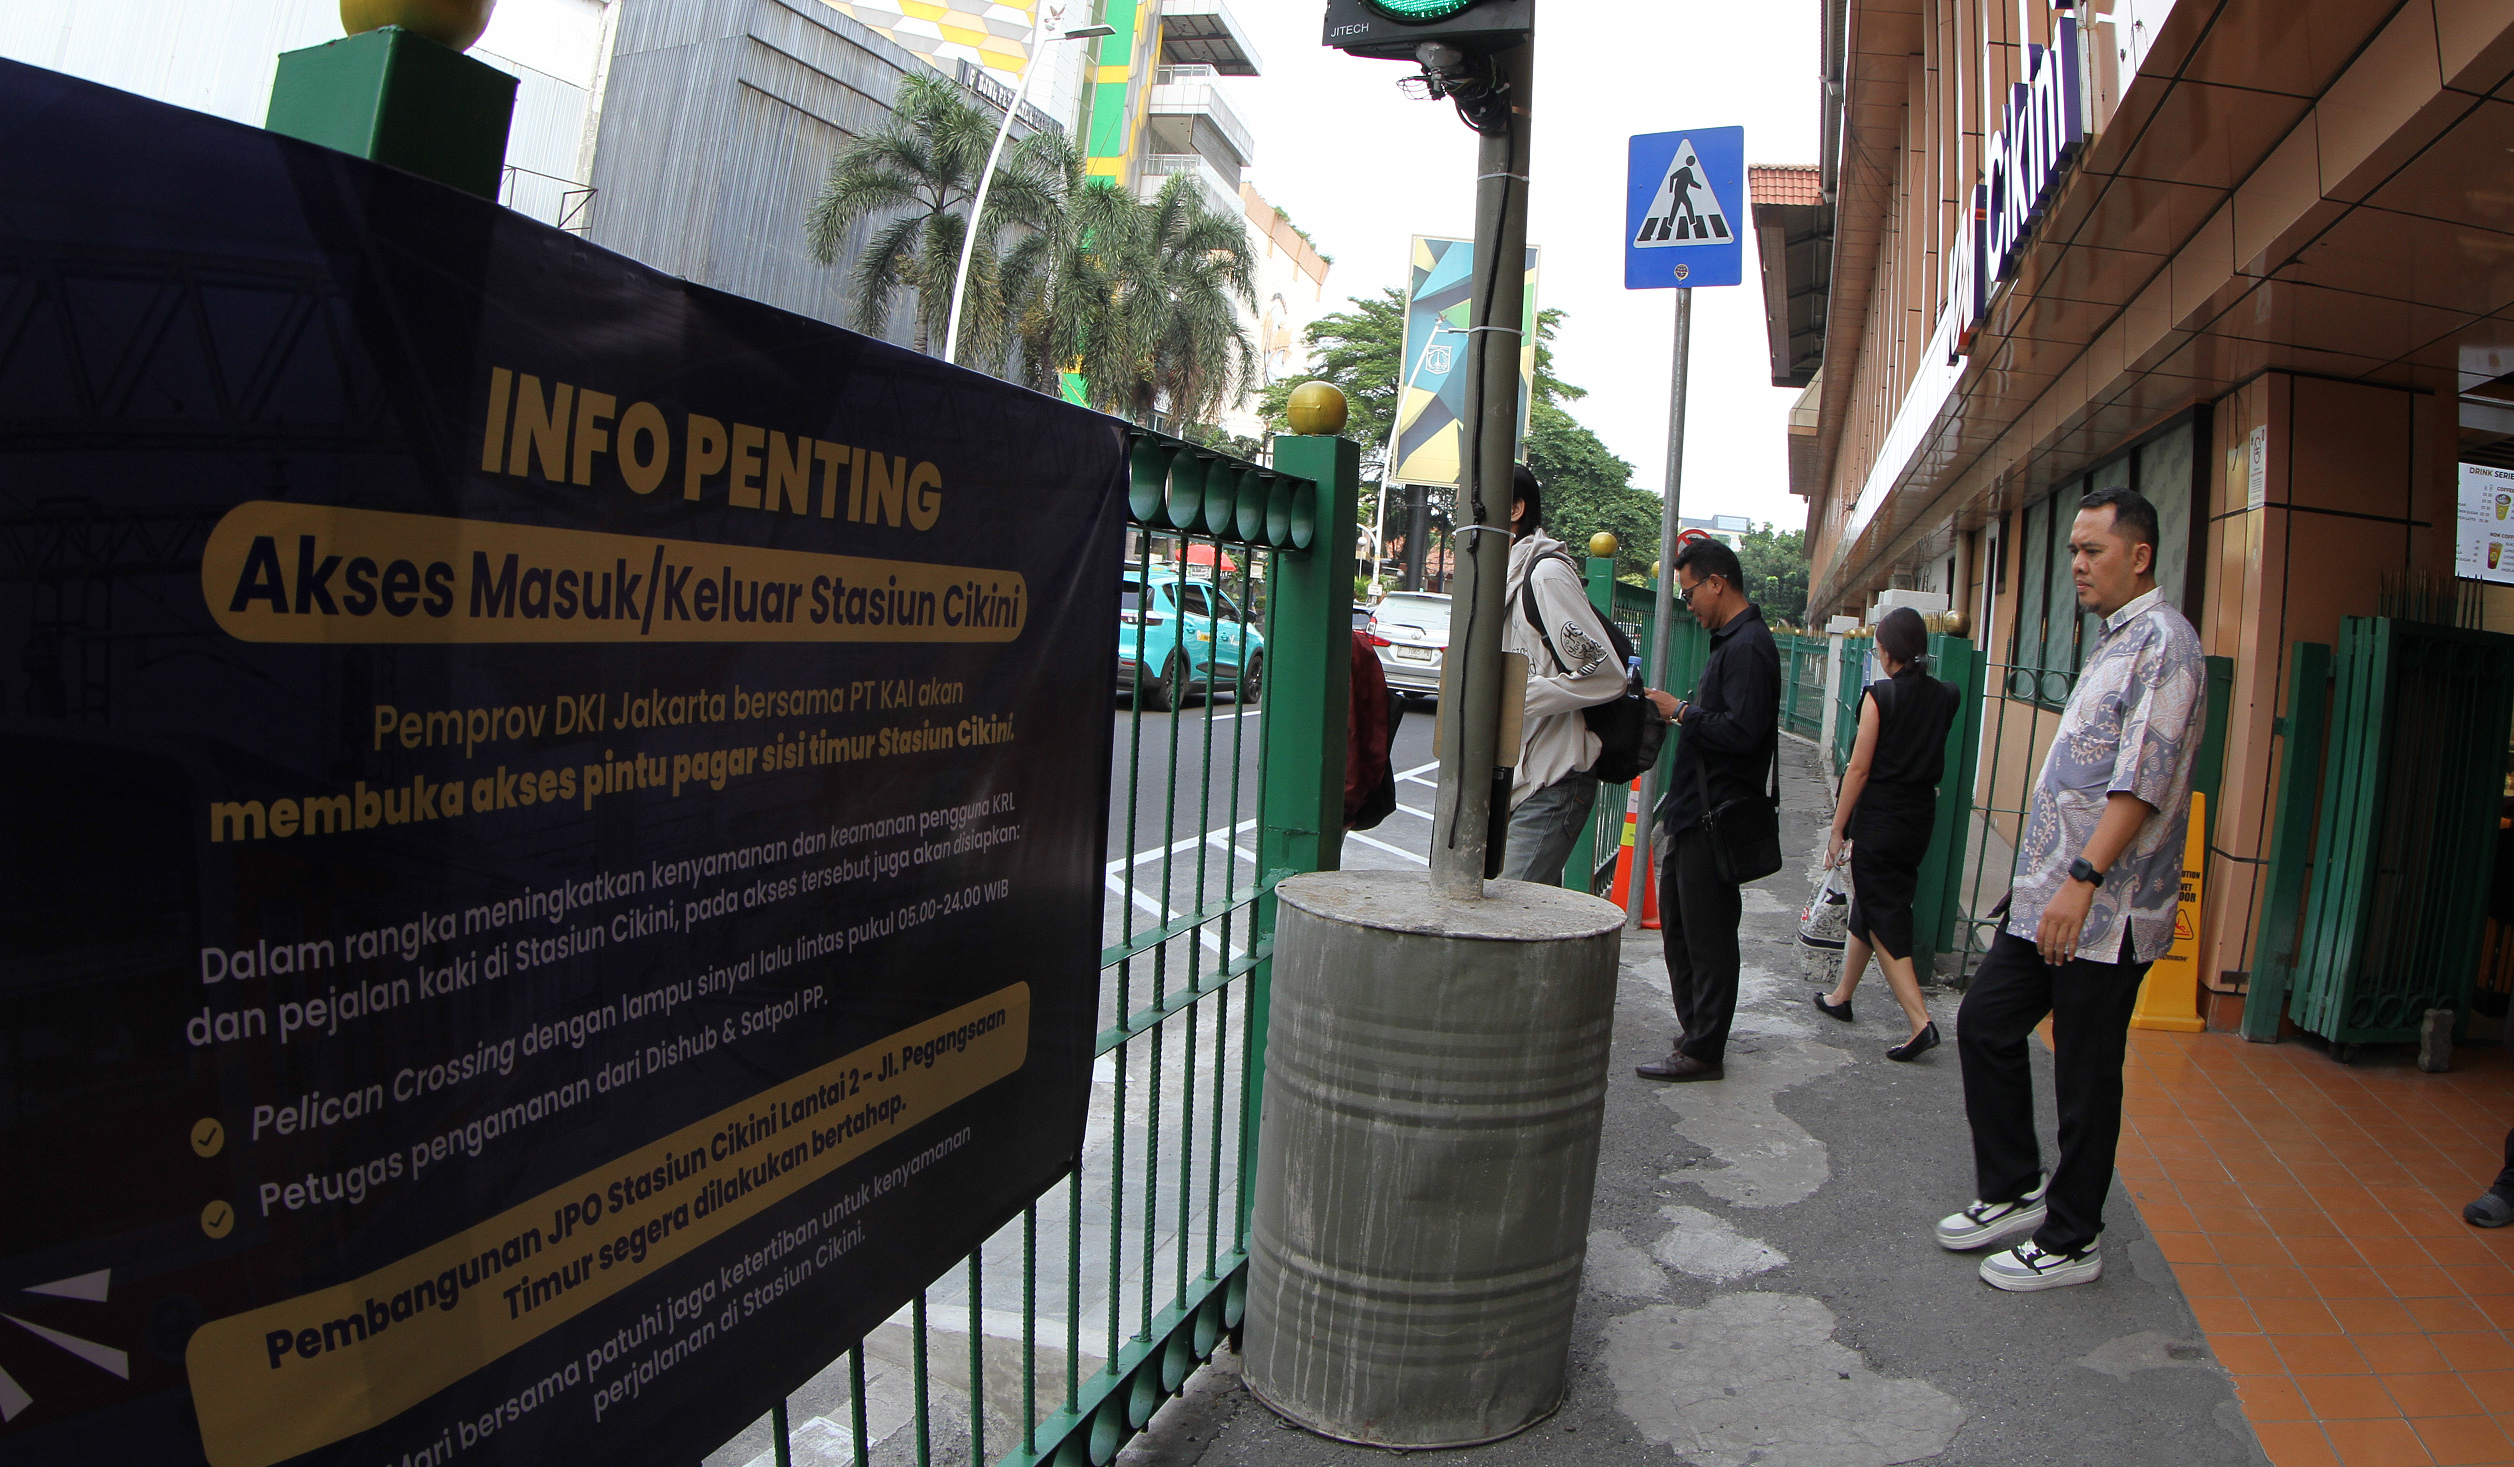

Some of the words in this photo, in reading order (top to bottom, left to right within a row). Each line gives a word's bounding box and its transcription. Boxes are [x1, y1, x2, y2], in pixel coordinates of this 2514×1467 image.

[1330, 22, 1369, 37] JITECH
[481, 366, 670, 495] INFO
[684, 413, 942, 531] PENTING
[2469, 467, 2493, 476] DRINK
[2494, 470, 2514, 480] SERIE
[228, 535, 455, 618] Akses
[469, 545, 802, 635] Masuk/Keluar
[810, 575, 936, 627] Stasiun
[943, 581, 1020, 628] Cikini
[211, 775, 464, 842] membuka
[472, 765, 576, 813] akses
[584, 749, 667, 810] pintu
[673, 747, 757, 797] pagar
[762, 731, 805, 771] sisi
[810, 729, 875, 765] timur
[879, 720, 953, 757] Stasiun
[957, 713, 1014, 747] Cikini.
[374, 704, 547, 759] Pemprov
[554, 693, 606, 736] DKI
[613, 690, 726, 730] Jakarta
[734, 685, 844, 720] bersama
[850, 681, 875, 710] PT
[881, 677, 914, 709] KAI
[918, 677, 963, 705] akan
[186, 1007, 266, 1046] dan
[279, 979, 409, 1044] pejalan
[419, 951, 477, 999] kaki
[484, 942, 508, 980] di
[516, 923, 604, 971] Stasiun
[611, 900, 679, 942] Cikini,
[685, 887, 738, 932] pada
[744, 875, 797, 904] akses
[801, 856, 870, 894] tersebut
[872, 849, 909, 881] juga
[913, 838, 950, 864] akan
[953, 824, 1020, 856] disiapkan:
[201, 939, 335, 984] Dalam
[345, 911, 456, 962] rangka
[464, 868, 645, 935] meningkatkan
[652, 839, 787, 893] kenyamanan
[793, 831, 825, 857] dan
[830, 815, 915, 849] keamanan
[920, 798, 989, 838] pengguna
[993, 792, 1015, 814] KRL
[2178, 892, 2196, 903] OOR
[2181, 870, 2200, 879] UTION
[253, 1084, 383, 1140] Pelican
[394, 1038, 515, 1101] Crossing
[522, 1004, 616, 1056] dengan
[622, 980, 692, 1022] lampu
[698, 953, 755, 996] sinyal
[760, 943, 792, 974] lalu
[797, 930, 843, 963] lintas
[848, 911, 894, 953] pukul
[899, 887, 980, 931] 05.00-24.00
[984, 878, 1009, 901] WIB
[260, 1152, 403, 1216] Petugas
[412, 1078, 589, 1179] pengamanan
[597, 1053, 640, 1093] dari
[647, 1027, 717, 1071] Dishub
[722, 1018, 736, 1042] &
[741, 993, 799, 1035] Satpol
[803, 985, 828, 1012] PP.
[265, 1227, 541, 1369] Pembangunan
[547, 1193, 602, 1245] JPO
[608, 1144, 706, 1212] Stasiun
[711, 1105, 777, 1162] Cikini
[781, 1072, 845, 1129] Lantai
[849, 1069, 860, 1094] 2
[877, 1052, 899, 1082] Jl.
[902, 1008, 1005, 1071] Pegangsaan
[459, 1360, 580, 1450] bersama
[587, 1315, 663, 1381] patuhi
[669, 1280, 715, 1333] jaga
[721, 1218, 818, 1292] ketertiban
[823, 1185, 869, 1229] untuk
[874, 1126, 971, 1191] kenyamanan
[503, 1254, 594, 1319] Timur
[600, 1209, 689, 1269] segera
[694, 1144, 808, 1219] dilakukan
[812, 1095, 906, 1154] bertahap.
[593, 1324, 715, 1422] perjalanan
[720, 1300, 738, 1331] di
[744, 1259, 811, 1316] Stasiun
[815, 1221, 866, 1268] Cikini.
